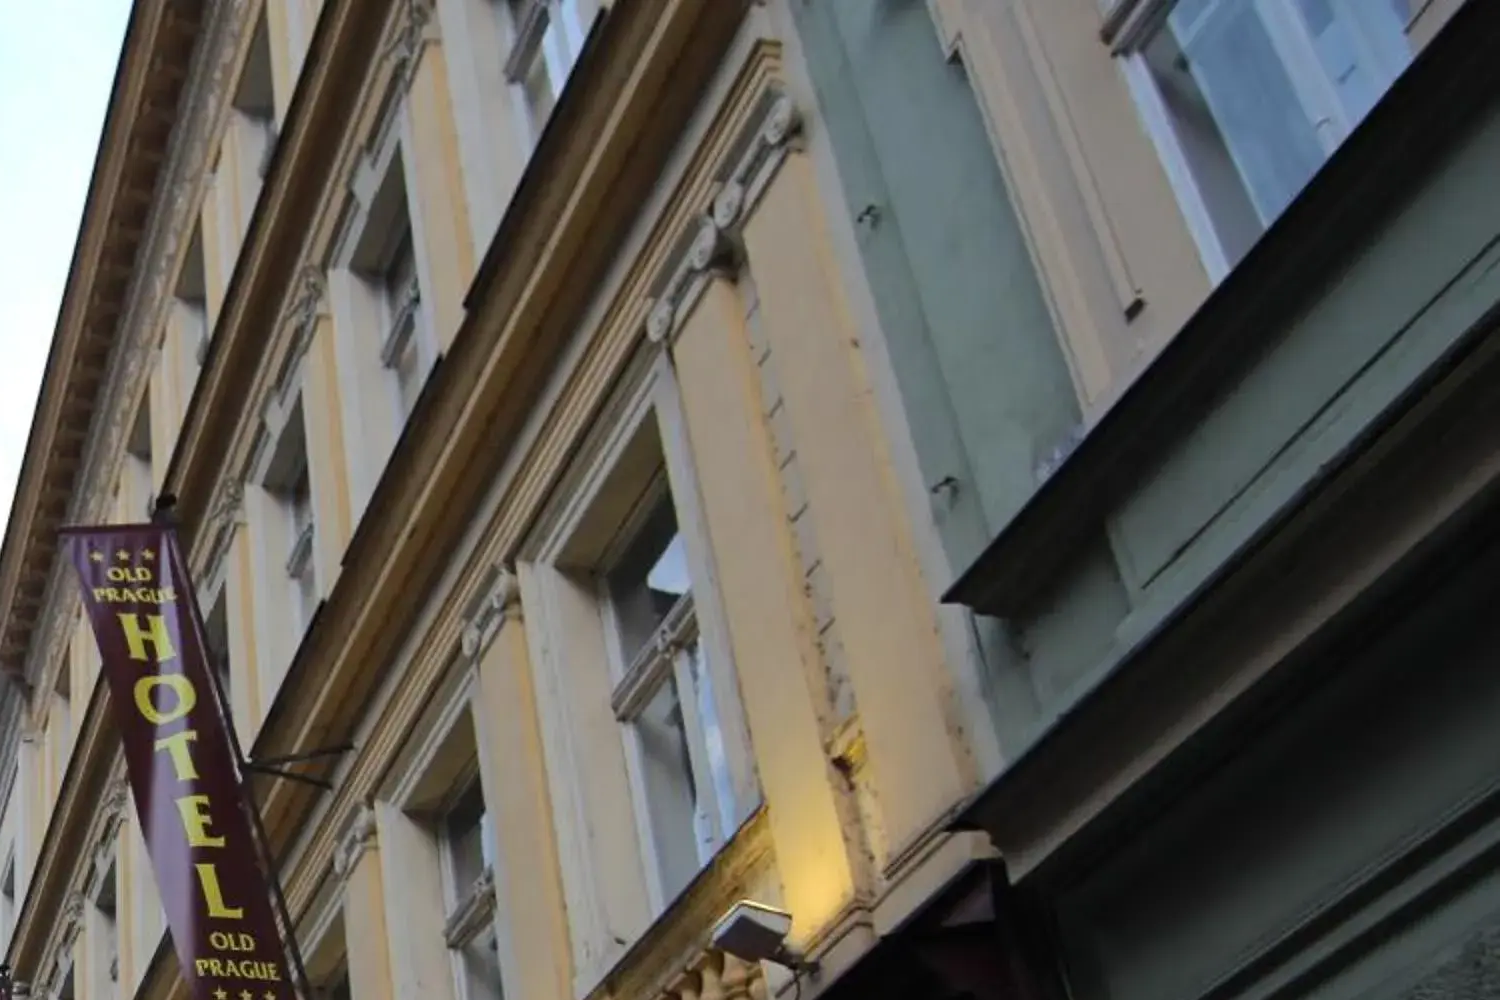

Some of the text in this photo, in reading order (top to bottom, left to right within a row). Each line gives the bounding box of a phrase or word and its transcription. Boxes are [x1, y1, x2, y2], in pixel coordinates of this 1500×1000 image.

[107, 566, 153, 582] OLD
[92, 586, 178, 604] PRAGUE
[116, 612, 244, 920] HOTEL
[209, 932, 256, 954] OLD
[195, 958, 282, 982] PRAGUE
